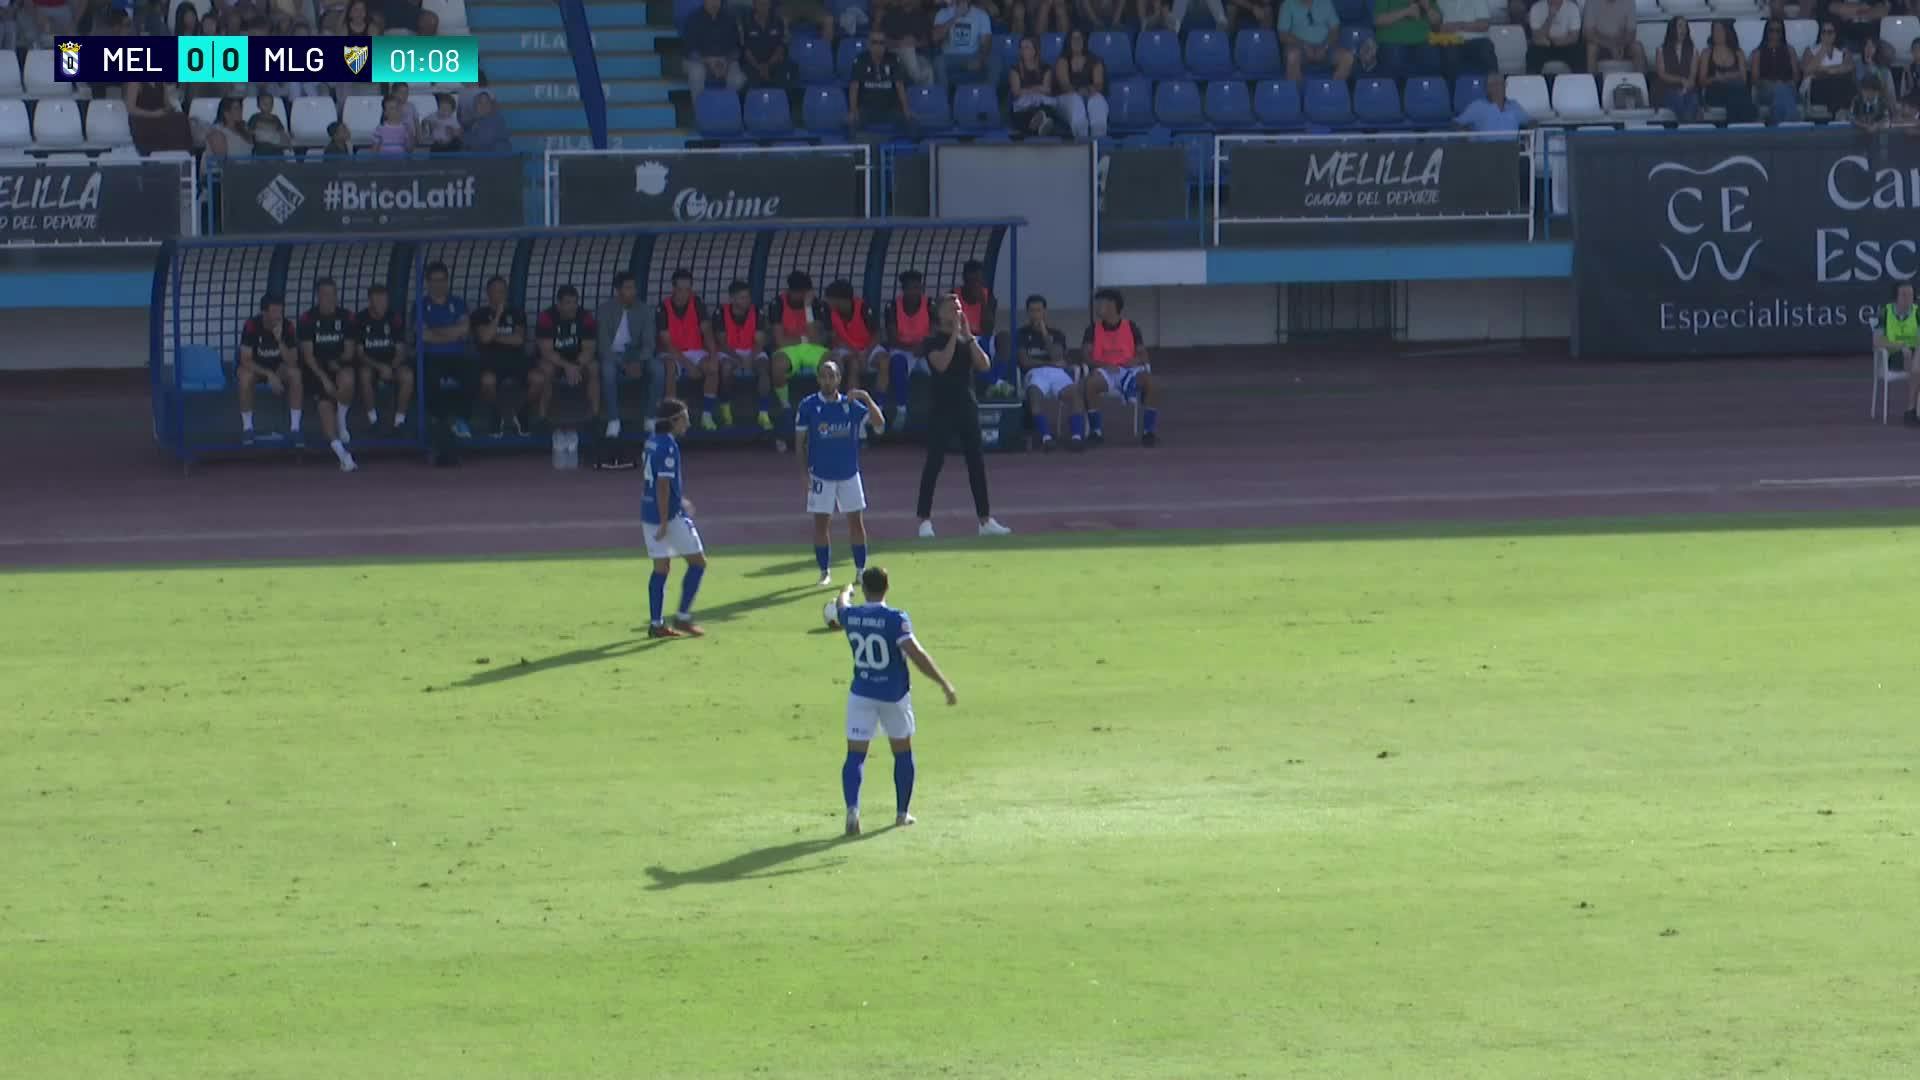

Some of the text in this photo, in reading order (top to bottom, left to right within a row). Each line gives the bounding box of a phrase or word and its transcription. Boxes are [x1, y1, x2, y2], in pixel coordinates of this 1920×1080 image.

[1304, 148, 1444, 189] MELILLA
[324, 176, 475, 211] #BricoLatif
[1357, 191, 1380, 206] DEL
[1387, 189, 1441, 206] DEPORTE
[13, 215, 38, 230] DEL
[43, 214, 97, 230] DEPORTE
[1660, 299, 1848, 335] Especialistas
[848, 631, 890, 671] 20
